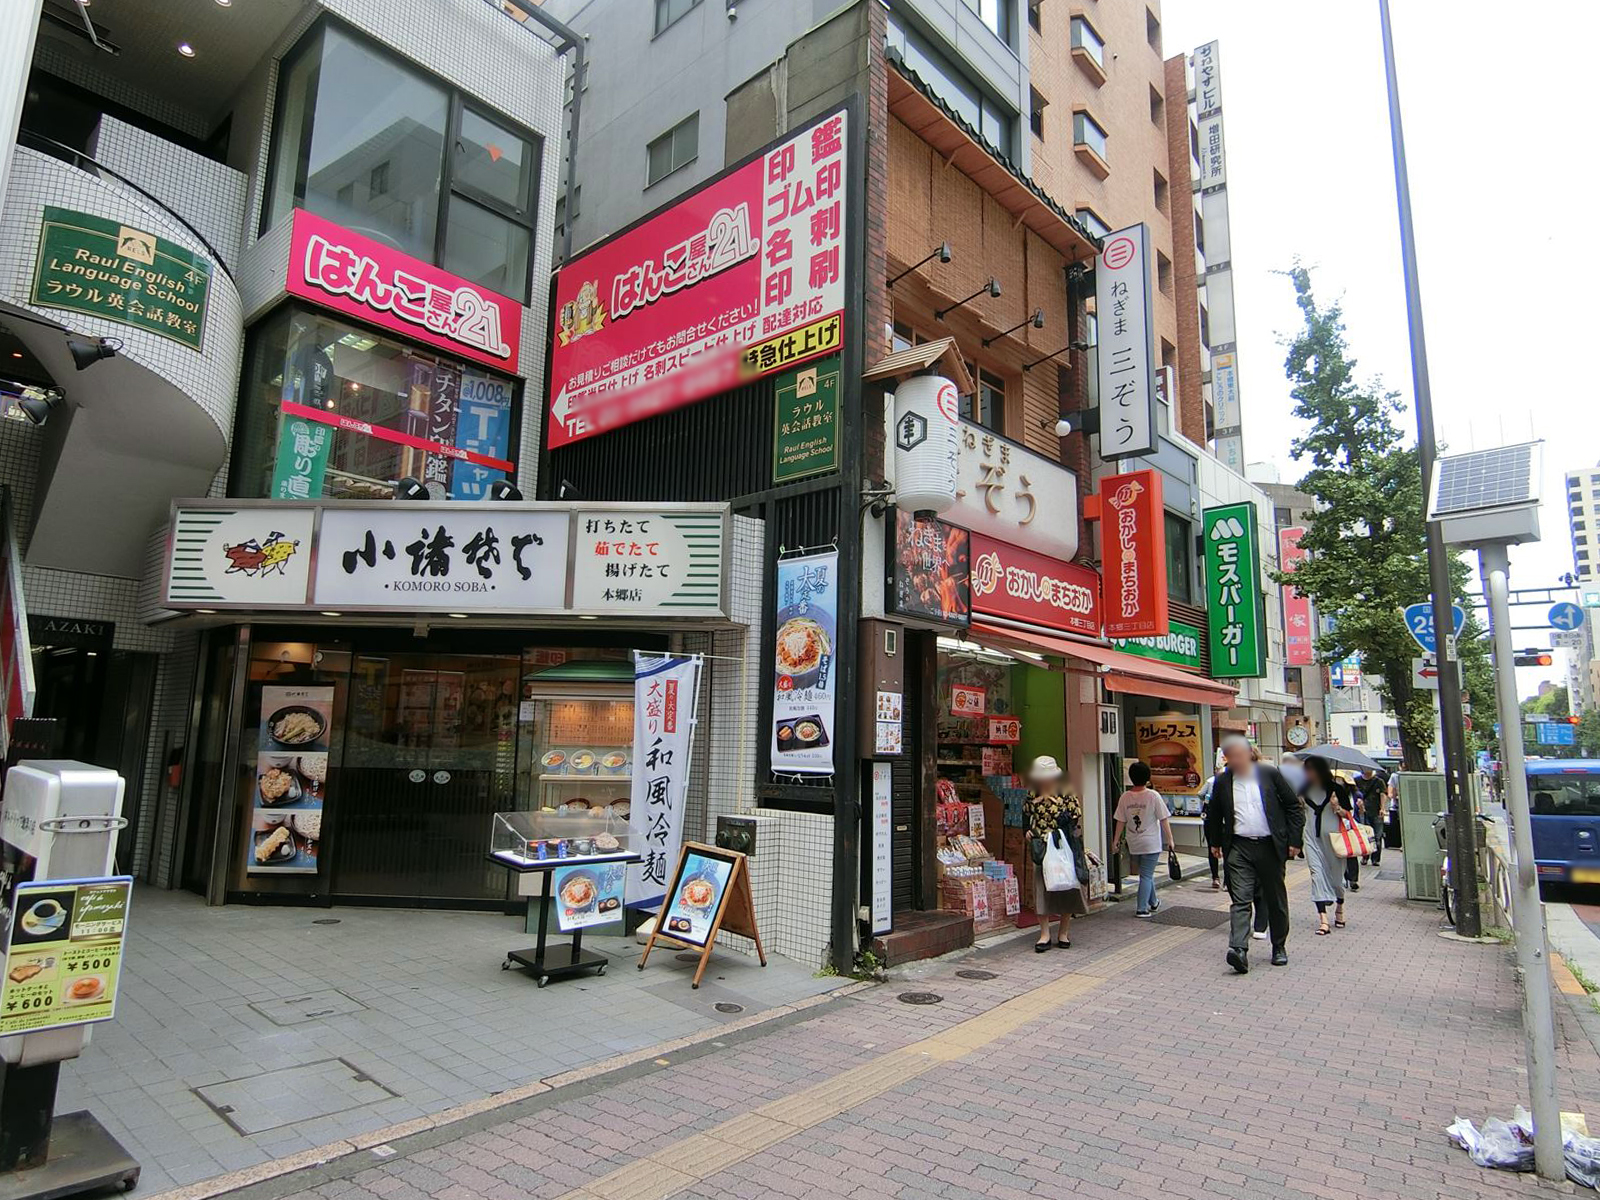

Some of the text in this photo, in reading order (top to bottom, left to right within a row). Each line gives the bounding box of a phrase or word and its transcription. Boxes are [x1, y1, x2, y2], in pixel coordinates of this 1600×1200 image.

[768, 116, 842, 185] 印鑑
[1208, 124, 1222, 177] 増田研究所
[767, 160, 841, 227] ゴム印
[765, 200, 841, 268] 名刺
[50, 258, 200, 314] Language School
[75, 247, 187, 293] Raul English
[184, 270, 205, 286] 4F
[764, 245, 840, 308] 印刷
[46, 280, 198, 336] ラウル英会話教室
[762, 295, 824, 335] 配達対応
[1109, 281, 1136, 445] ねぎま 三ぞう
[566, 417, 592, 438] TE
[781, 411, 834, 437] 英会話教室
[792, 399, 825, 419] ラウル
[779, 444, 834, 464] Language School
[783, 437, 827, 454] Raul English
[962, 425, 1011, 465] ねぎま
[585, 519, 650, 535] 打ちたて
[594, 541, 660, 557] 茹でたて
[1119, 508, 1139, 618] おかしのまちおか
[393, 580, 488, 593] KOMORO SOBA
[605, 563, 670, 579] 揚げたて
[1006, 565, 1094, 615] おかしのまちおか
[601, 588, 642, 602] 本郷店
[1216, 542, 1242, 667] モスバーガー
[1108, 621, 1155, 632] 本郷三丁目店
[1156, 633, 1197, 656] BURGER
[646, 680, 663, 735] 大盛り
[1139, 724, 1197, 740] カレーフェス
